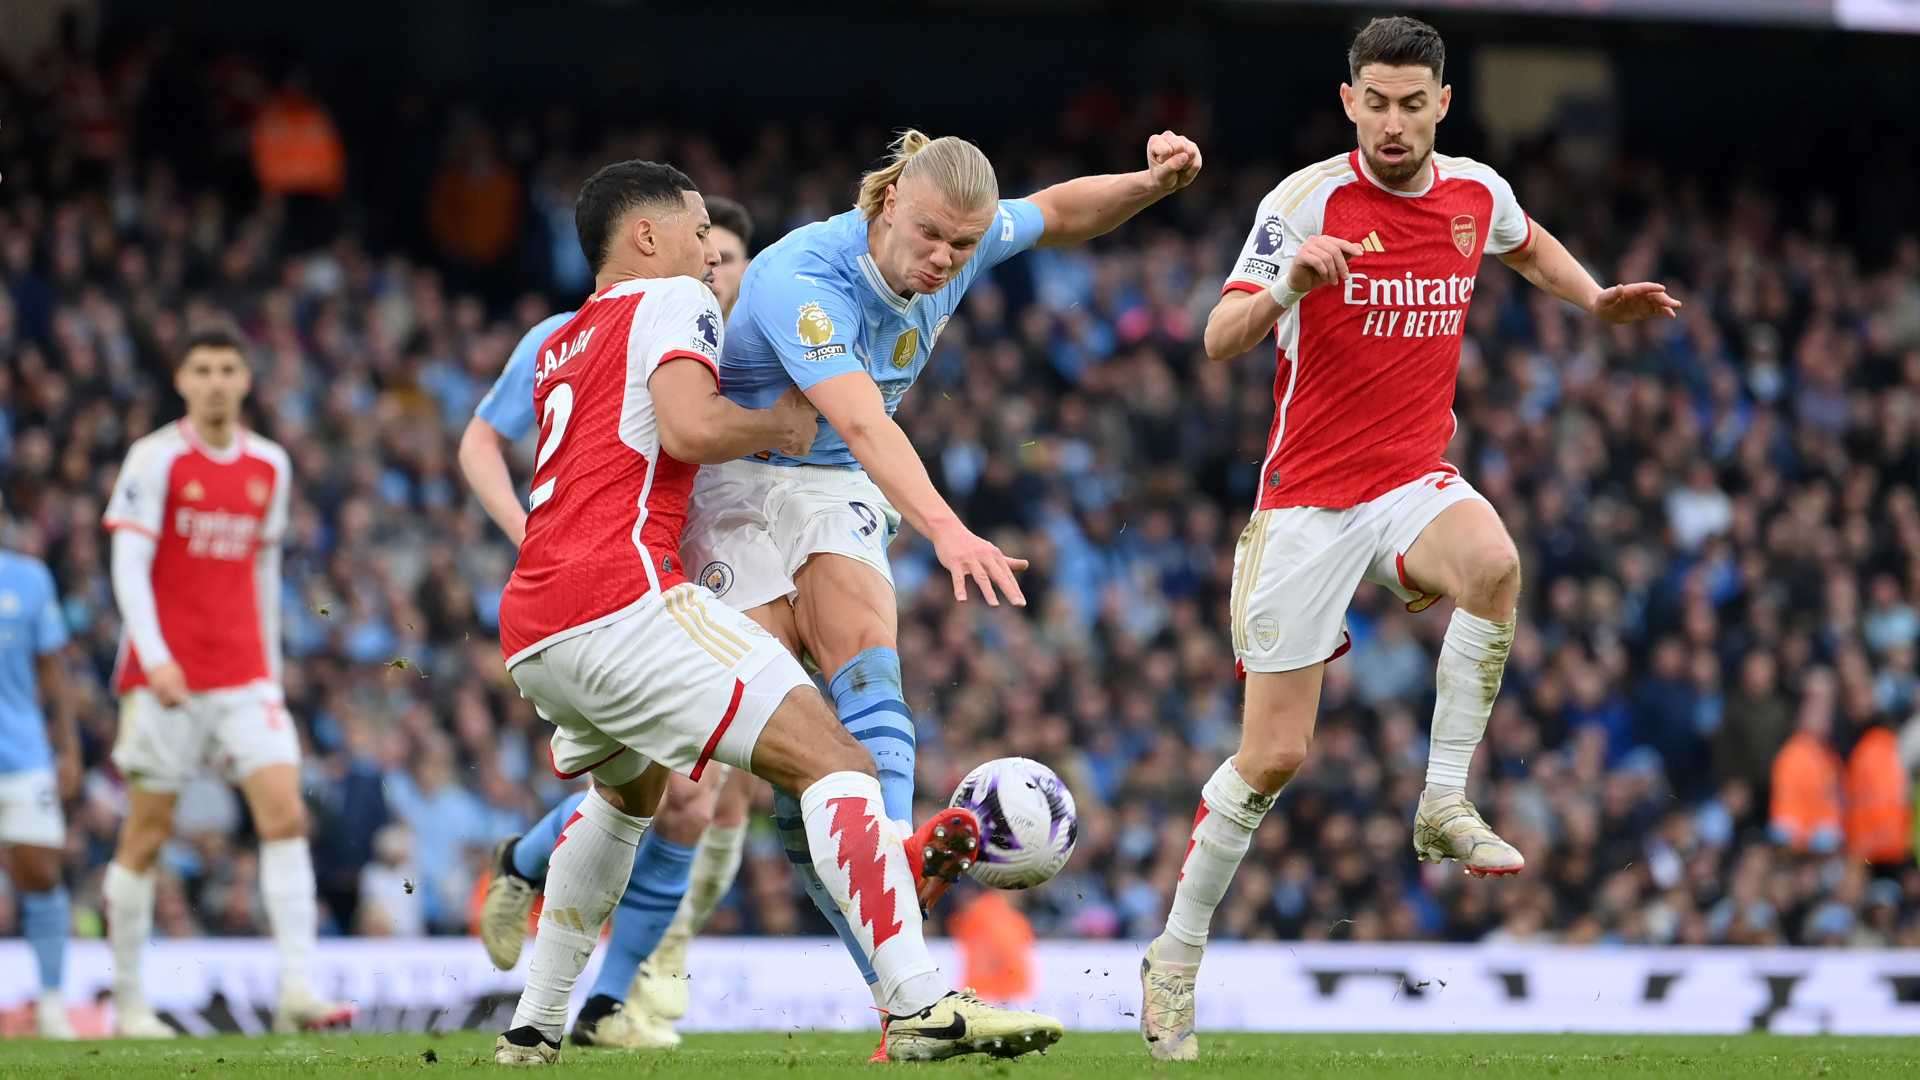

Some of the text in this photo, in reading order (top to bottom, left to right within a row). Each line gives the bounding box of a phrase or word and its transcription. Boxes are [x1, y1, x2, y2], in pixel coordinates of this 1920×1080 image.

[1362, 309, 1462, 337] FLY BETTER
[817, 344, 843, 356] room
[529, 382, 574, 513] 2
[848, 501, 878, 537] 9
